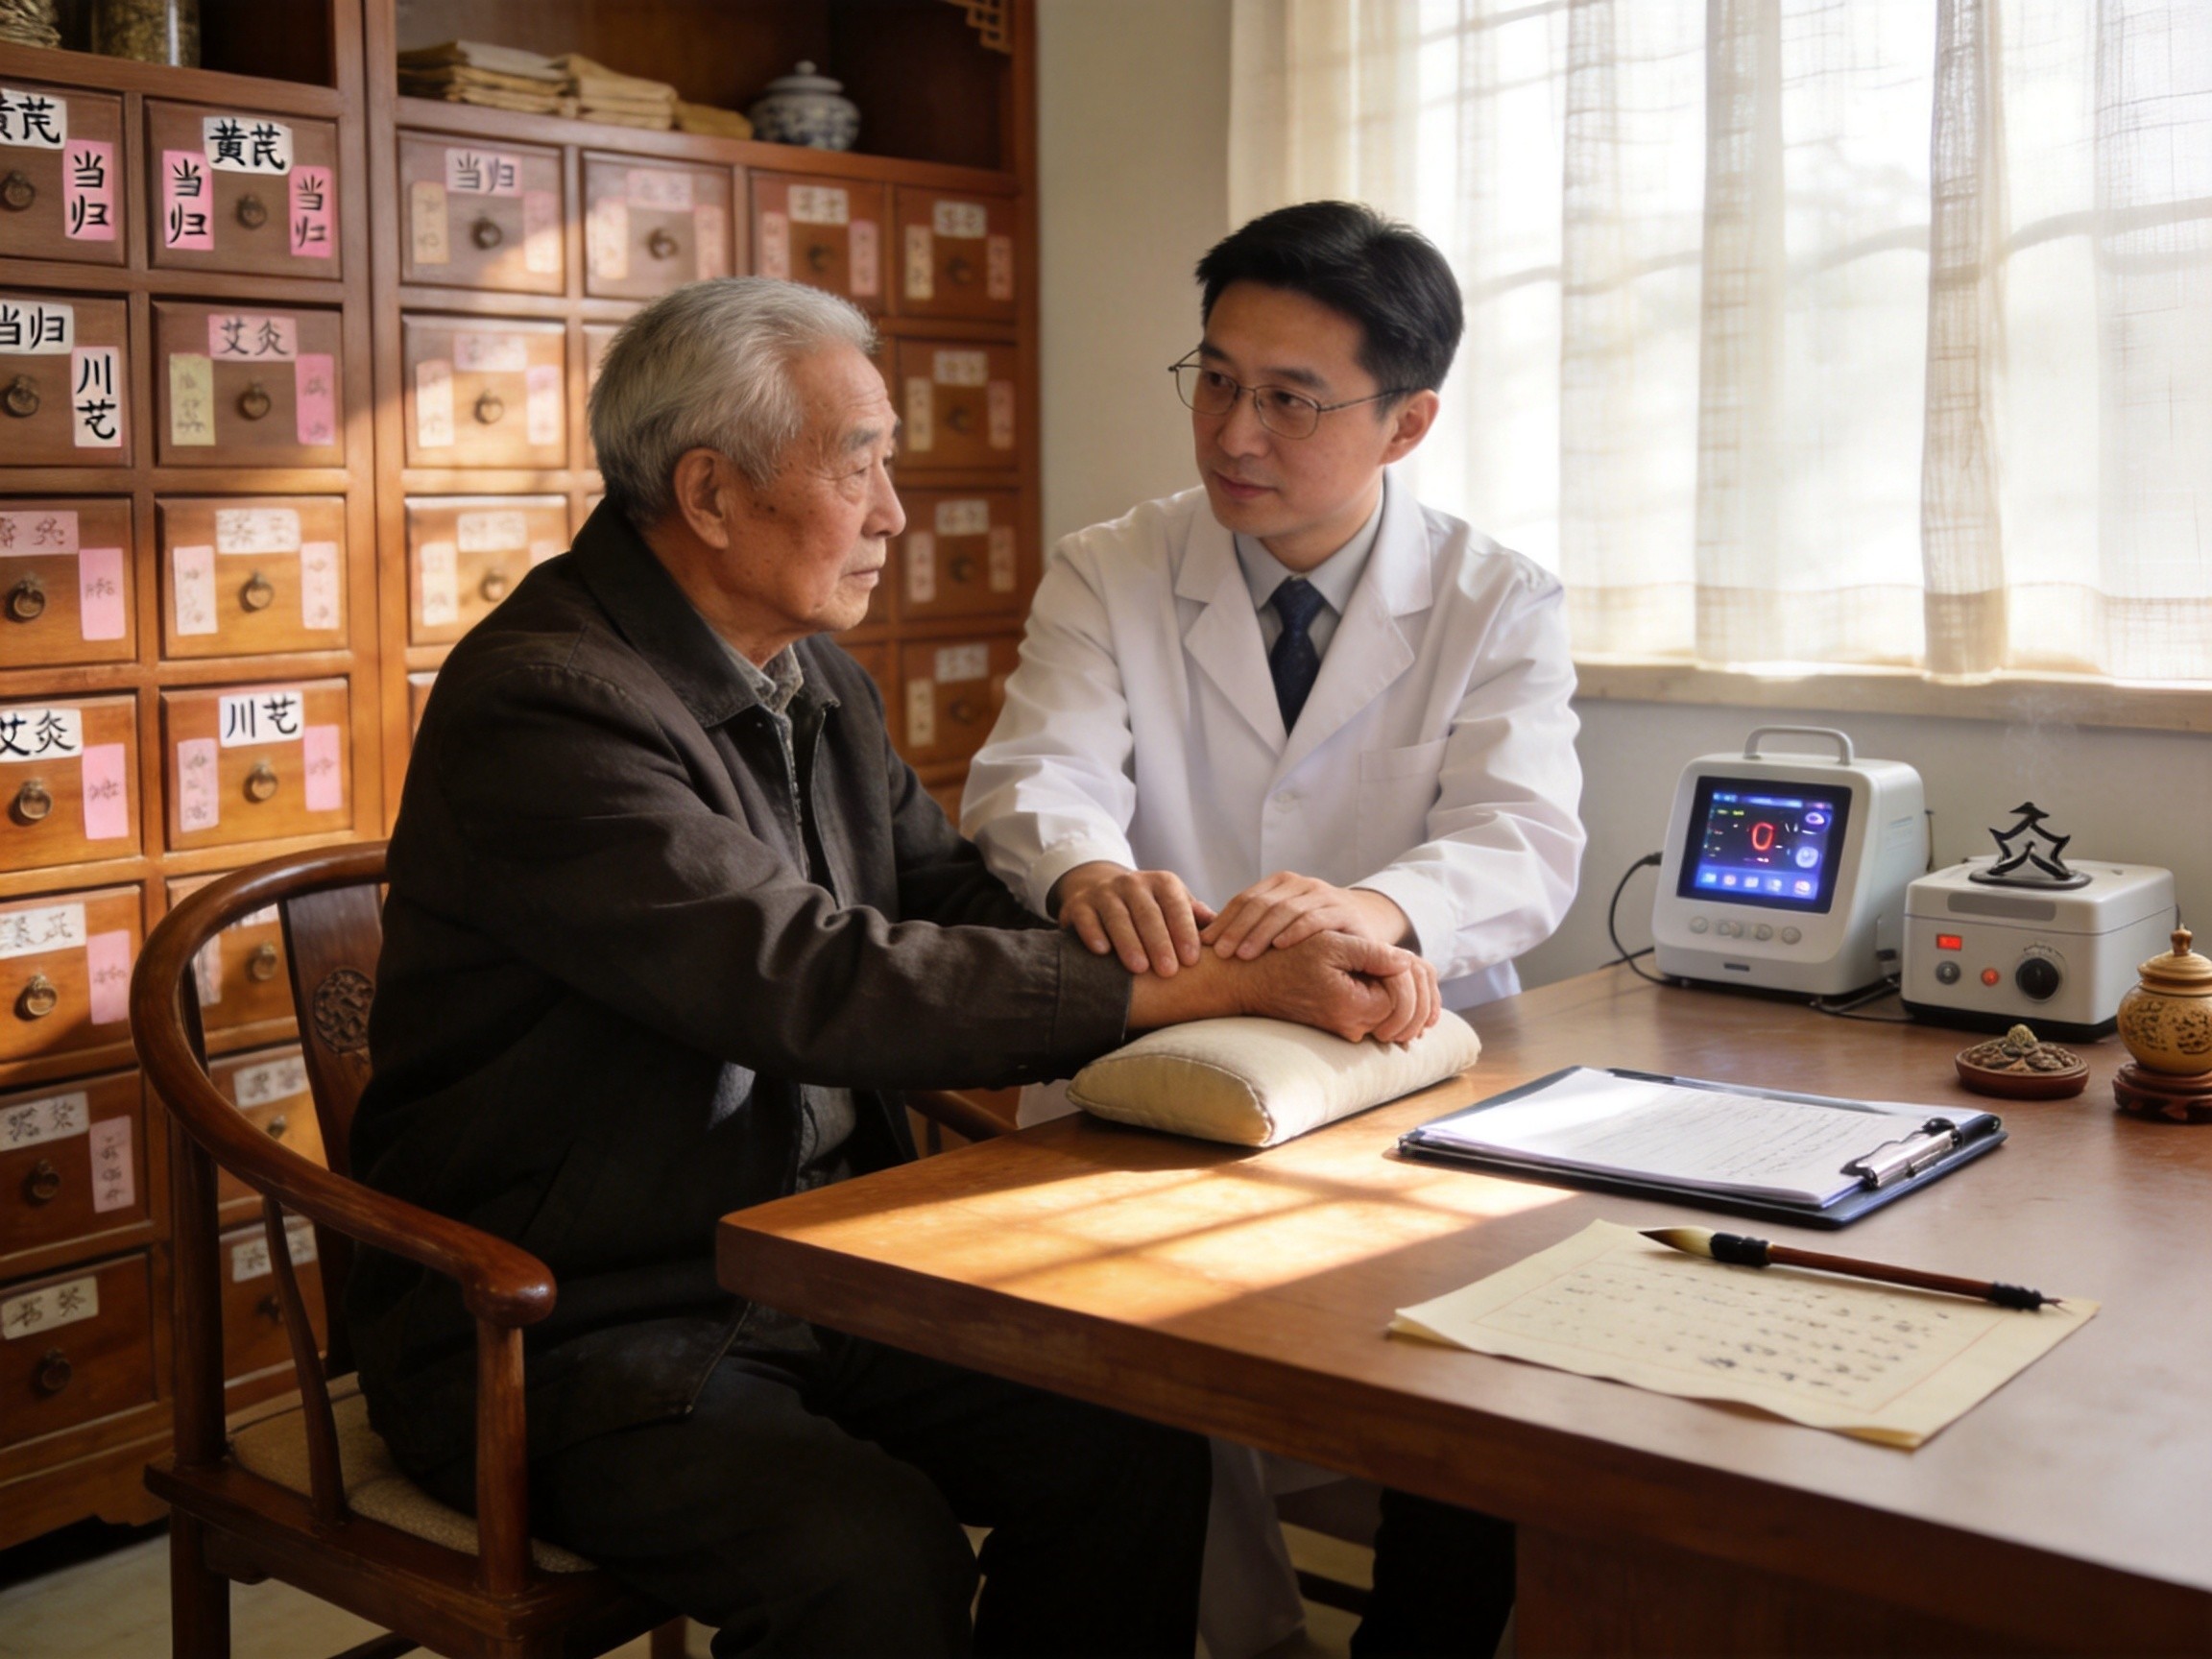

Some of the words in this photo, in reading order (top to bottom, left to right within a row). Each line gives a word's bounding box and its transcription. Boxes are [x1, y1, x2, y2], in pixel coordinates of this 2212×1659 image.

[208, 118, 285, 170] 黄芪
[71, 151, 108, 234] 当归
[455, 152, 515, 194] 当归
[169, 158, 207, 244] 当归
[296, 175, 326, 248] 当归
[0, 303, 64, 350] 当归
[219, 318, 290, 356] 艾灸
